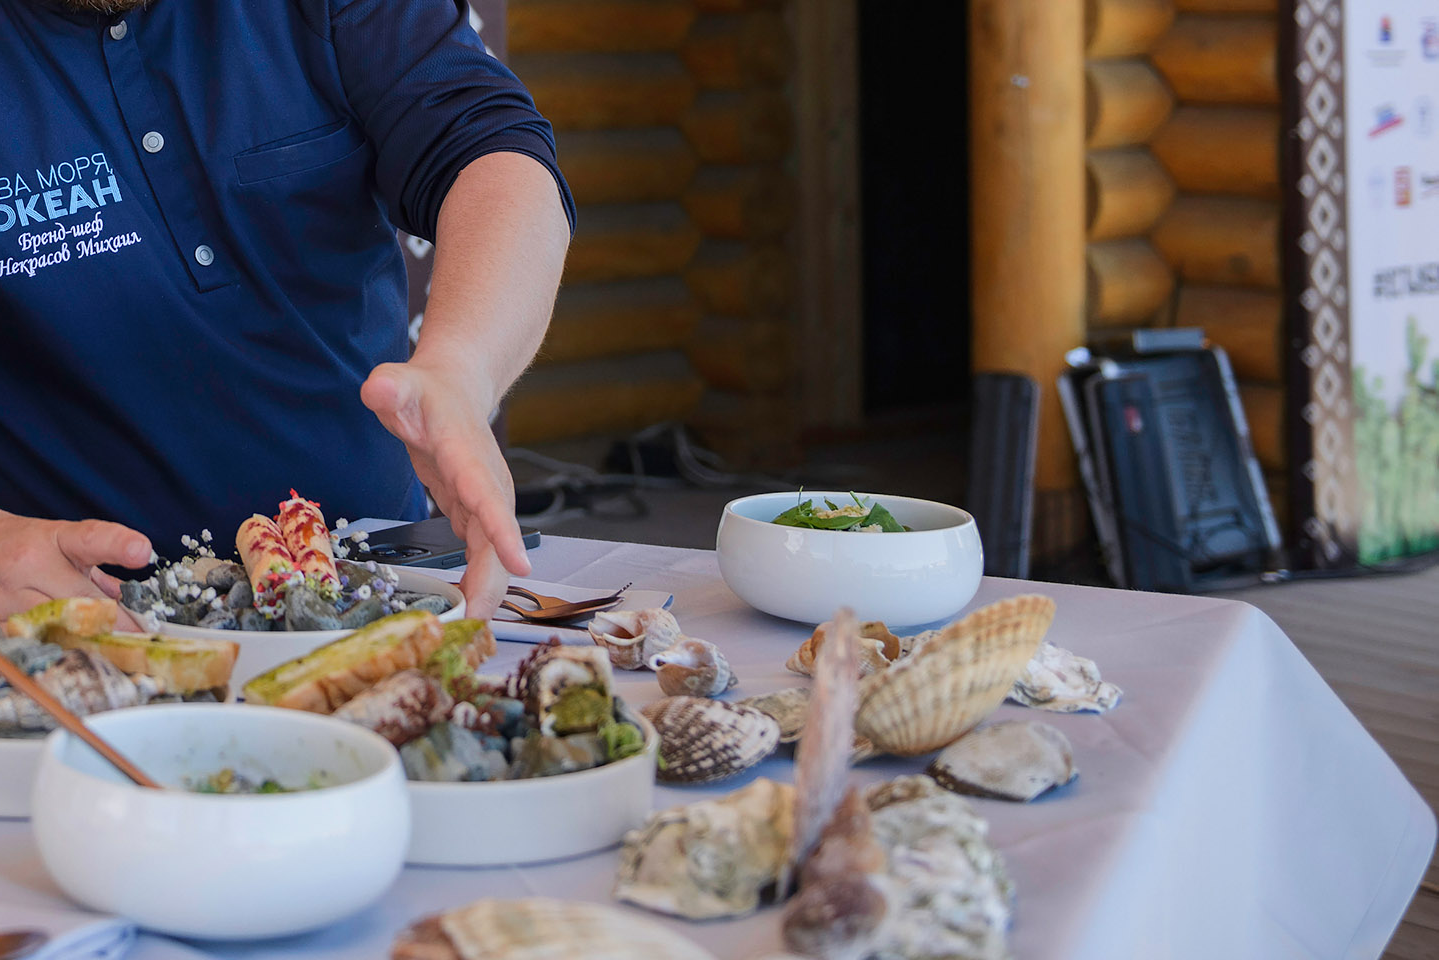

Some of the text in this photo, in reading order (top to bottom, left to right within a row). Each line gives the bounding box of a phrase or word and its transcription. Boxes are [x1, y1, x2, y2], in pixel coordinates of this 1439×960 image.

[36, 152, 113, 189] МОРЯ,
[18, 211, 104, 254] Бренд-шеф
[76, 231, 142, 259] Михаил
